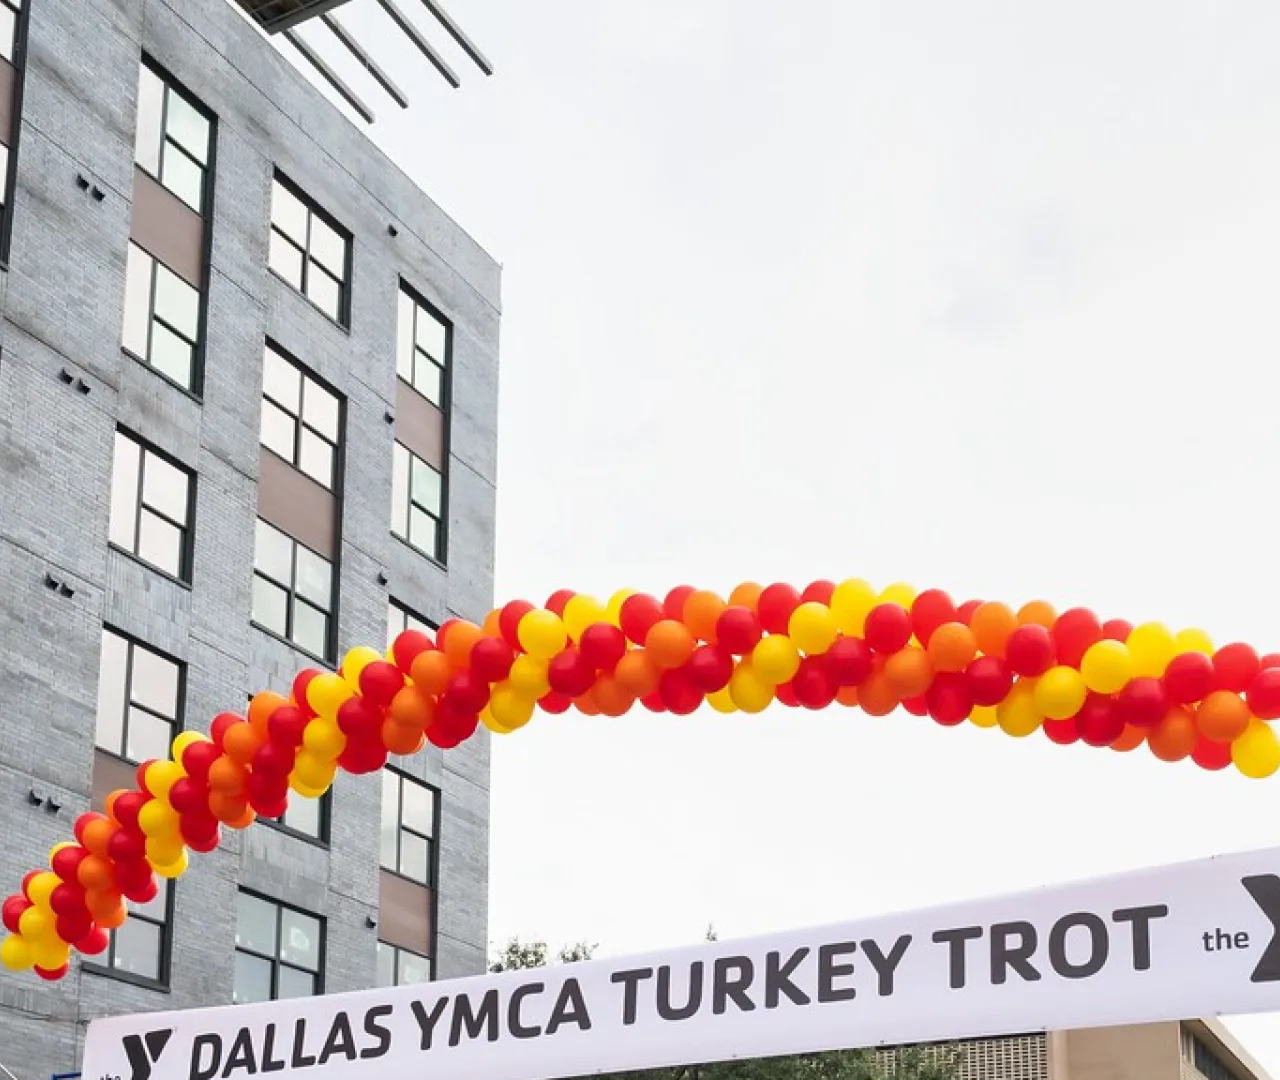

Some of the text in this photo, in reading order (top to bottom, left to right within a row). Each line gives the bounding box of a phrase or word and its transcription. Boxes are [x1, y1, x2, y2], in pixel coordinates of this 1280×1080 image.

[410, 977, 592, 1051] YMCA
[610, 934, 912, 1025] TURKEY
[932, 904, 1168, 989] TROT
[1202, 927, 1249, 952] the
